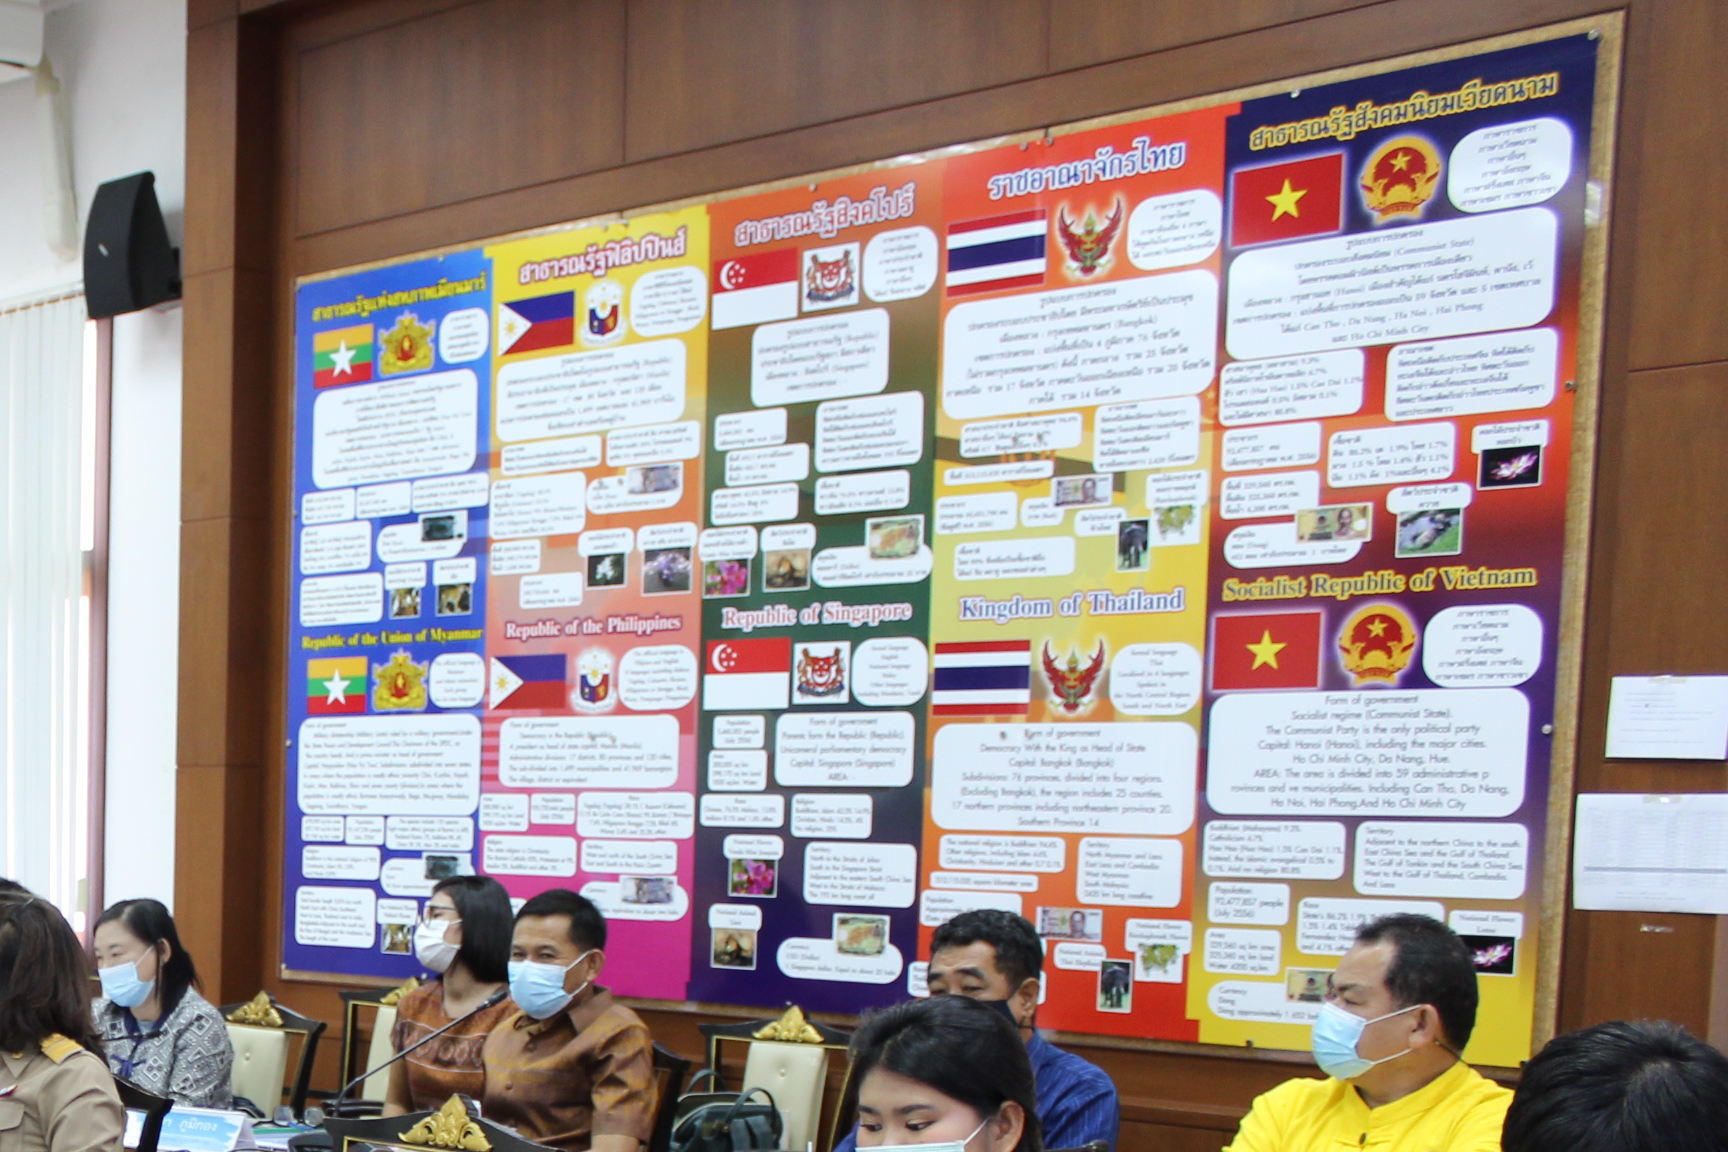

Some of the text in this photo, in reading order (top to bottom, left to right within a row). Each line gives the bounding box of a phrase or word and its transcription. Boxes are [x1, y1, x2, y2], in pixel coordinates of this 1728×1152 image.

[1250, 72, 1559, 150] สาธารณรัฐสังคมนิยมเวียดนาม
[988, 136, 1186, 200] ราชอาณาจักรไทย
[735, 182, 916, 246] สาธารณรัฐสิงคโปร์
[519, 225, 688, 285] สาธารณรัฐฟิลิปปินส์
[1222, 565, 1537, 601] Socialist Republic of Vietnam
[722, 601, 912, 632] Republic of Singapore
[959, 587, 1185, 623] Kingdom of Thailand
[302, 628, 484, 651] Republic of the Union of Myanmar
[505, 615, 682, 641] Republic of the Philippines
[1326, 694, 1418, 707] Form of government
[1292, 710, 1327, 720] Socialist
[1331, 712, 1362, 722] regime
[1266, 725, 1280, 734] The
[1284, 725, 1332, 735] Communist
[1336, 725, 1358, 737] Party
[1374, 724, 1387, 734] the
[1391, 723, 1411, 736] only
[1414, 723, 1451, 735] political
[1455, 725, 1480, 735] party
[1328, 753, 1351, 763] Minh
[1284, 769, 1300, 778] The
[1338, 768, 1371, 778] divided
[1269, 782, 1286, 792] and
